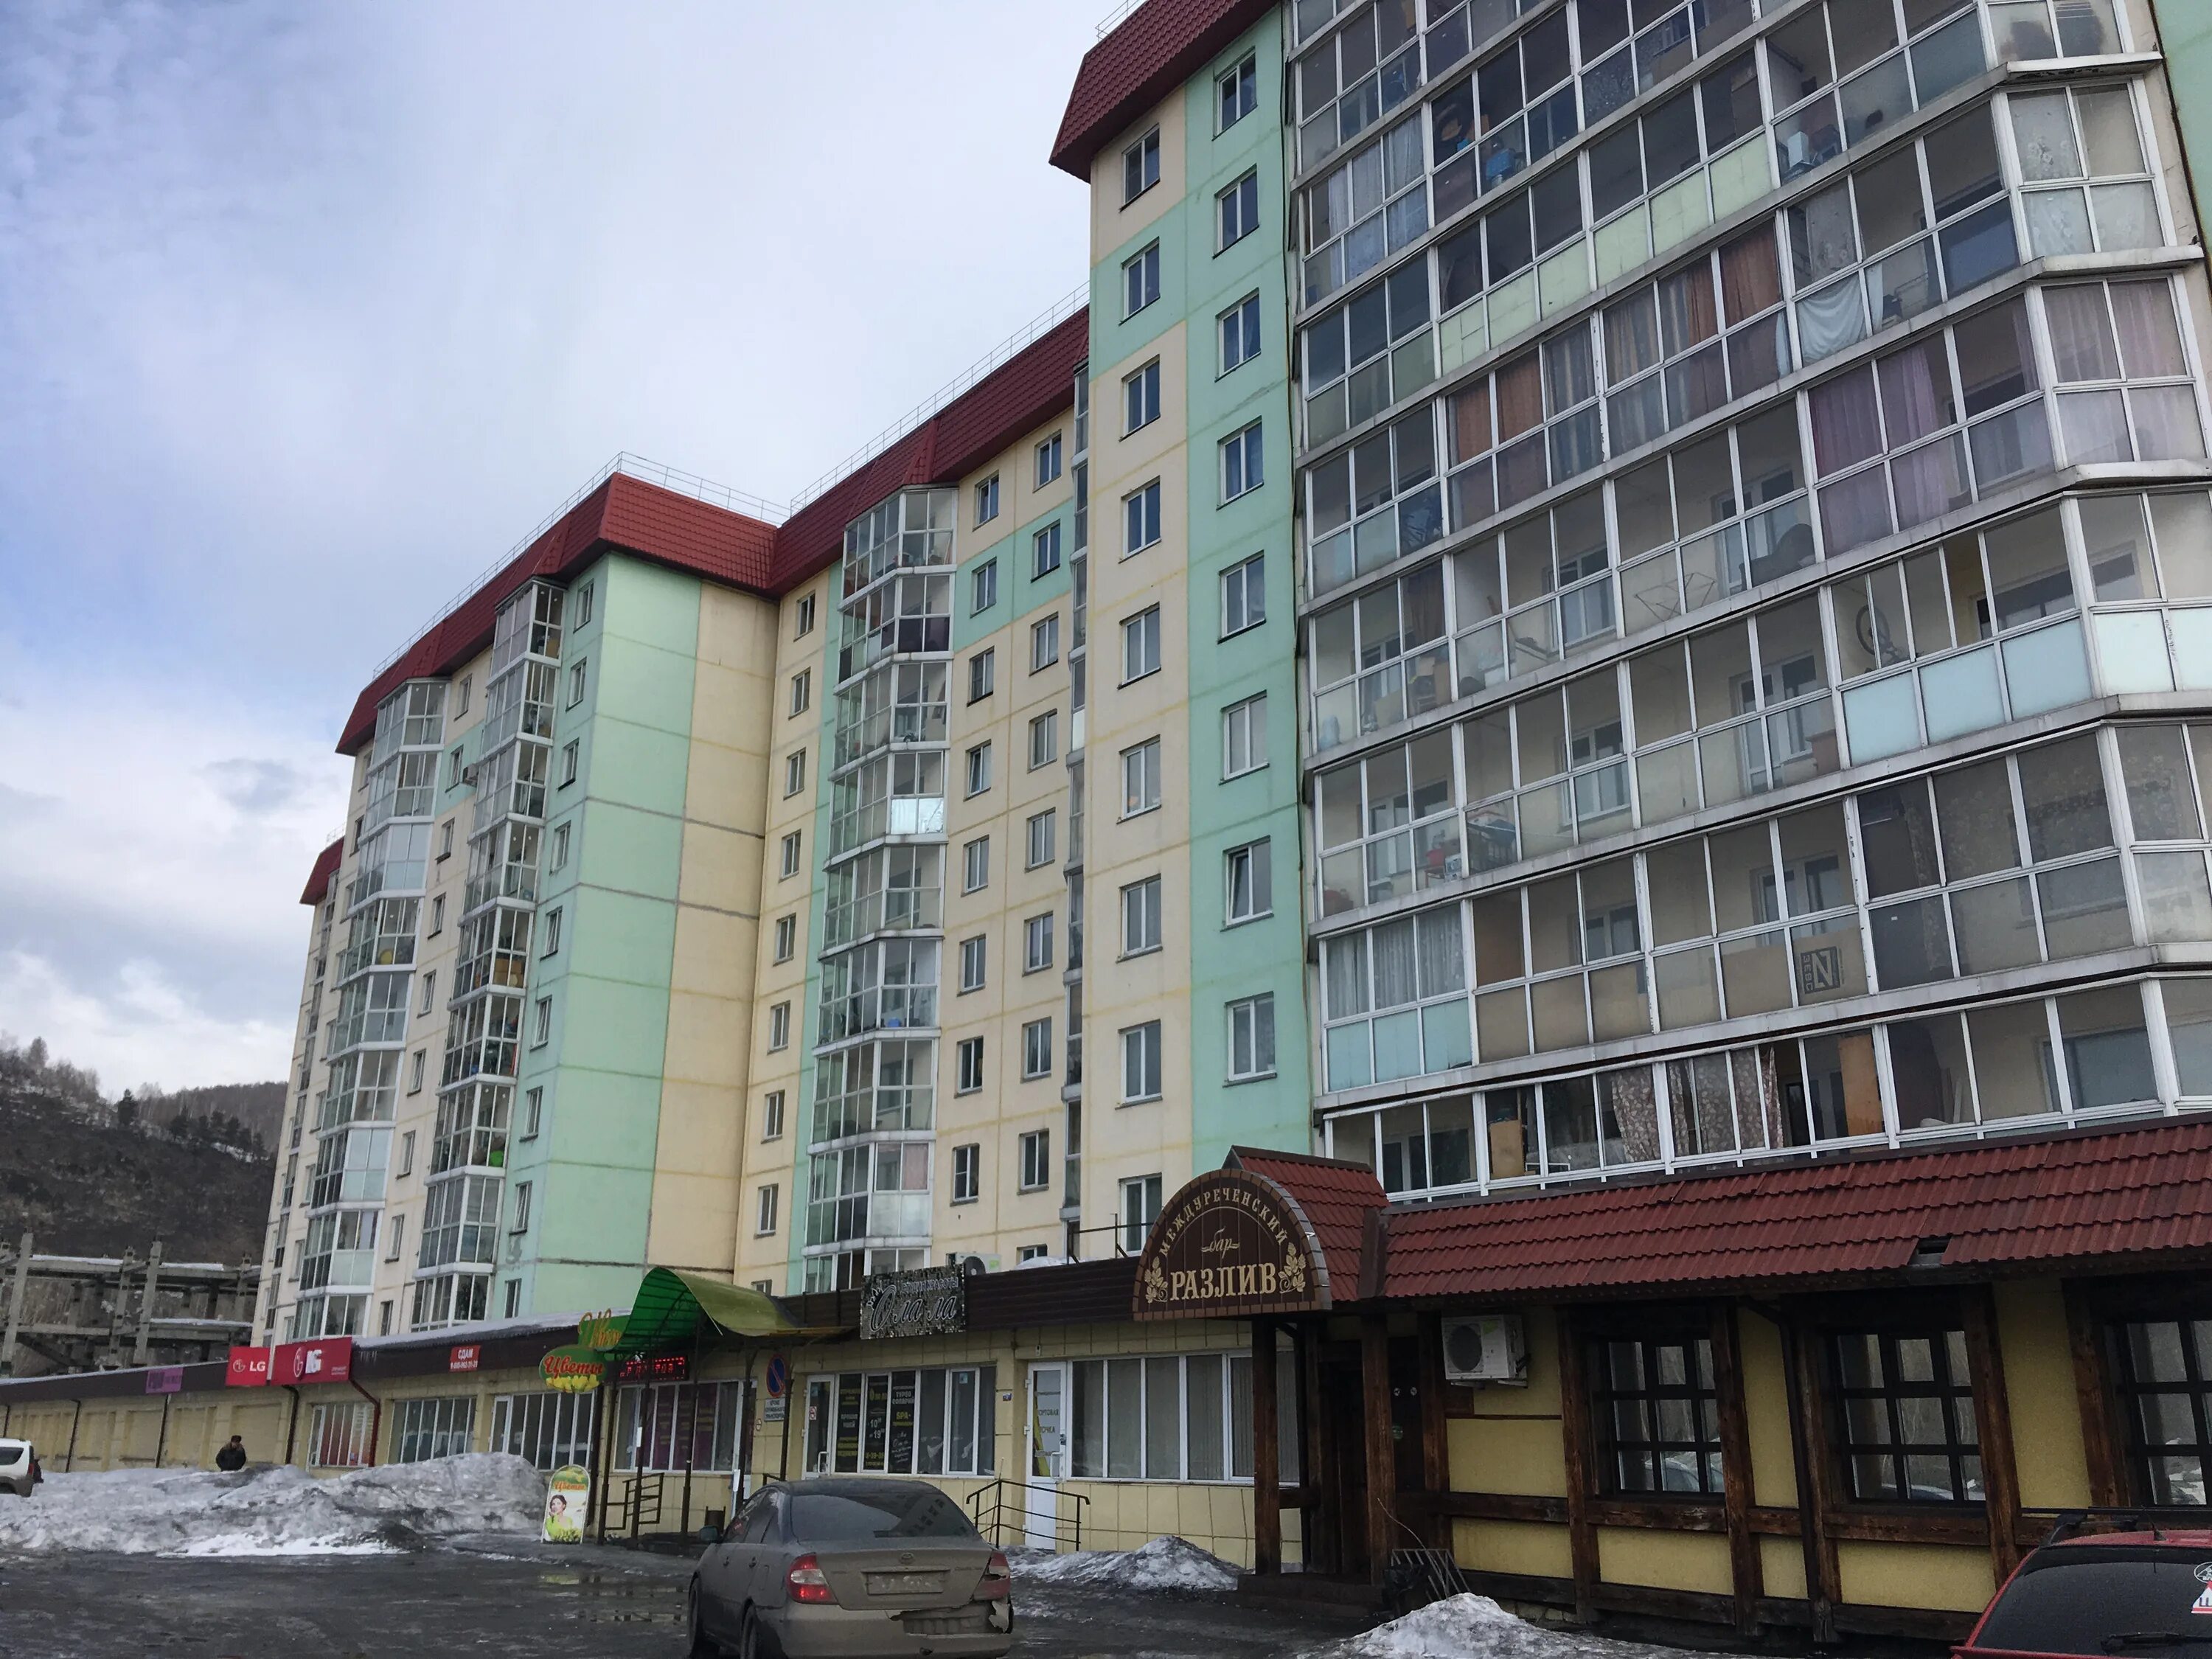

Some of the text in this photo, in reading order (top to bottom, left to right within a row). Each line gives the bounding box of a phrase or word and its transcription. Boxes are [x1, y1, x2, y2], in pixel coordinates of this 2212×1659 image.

[1158, 1187, 1288, 1257] МЕЖДУРЕЧЕНСКИЙ
[1206, 1226, 1237, 1259] бар
[1169, 1262, 1277, 1301] РАЗЛИВ
[250, 1360, 265, 1372] LG
[543, 1355, 606, 1380] Цветы
